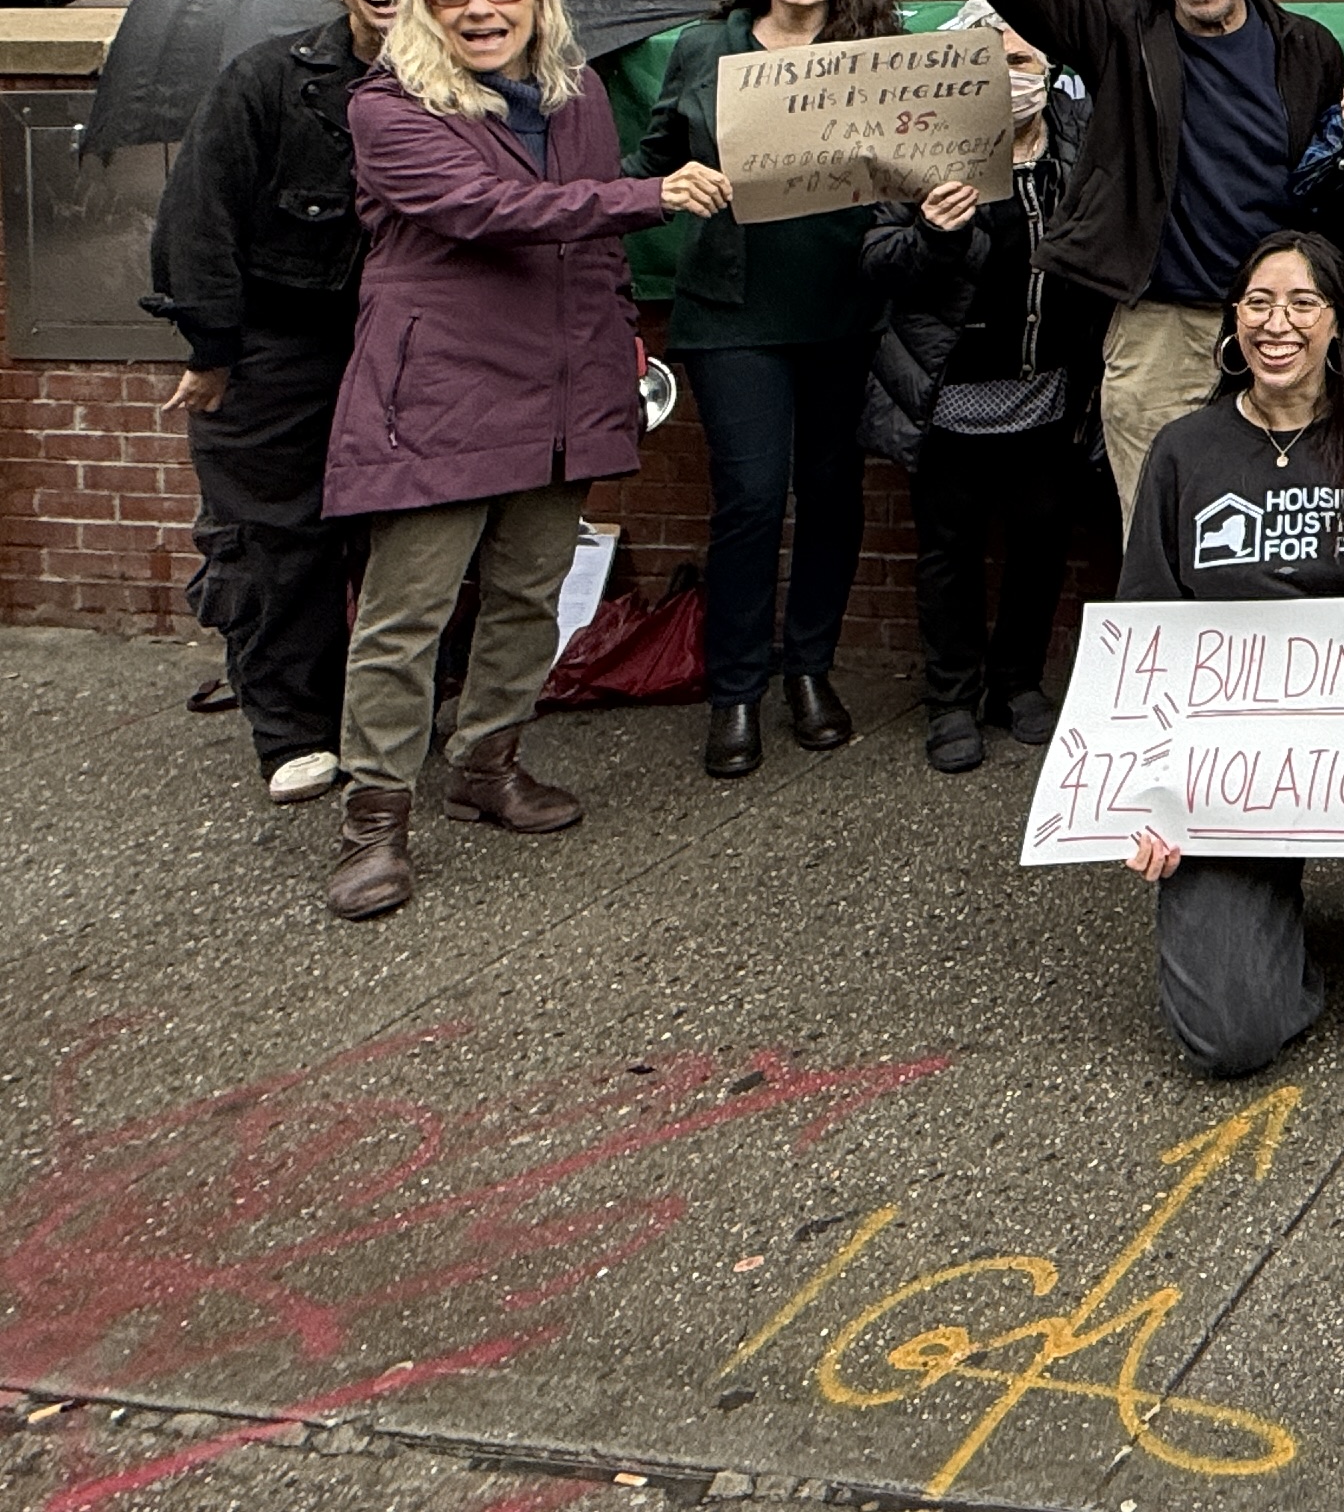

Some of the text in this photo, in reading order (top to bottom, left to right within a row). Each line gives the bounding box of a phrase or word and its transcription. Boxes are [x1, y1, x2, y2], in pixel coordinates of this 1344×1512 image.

[879, 80, 990, 104] NEGLECT
[843, 120, 885, 138] AM
[895, 110, 937, 134] 85
[783, 170, 852, 195] FIX
[923, 158, 987, 184] APT.
[1264, 536, 1318, 561] FOR
[1114, 626, 1167, 708] 14
[1060, 751, 1151, 829] 472
